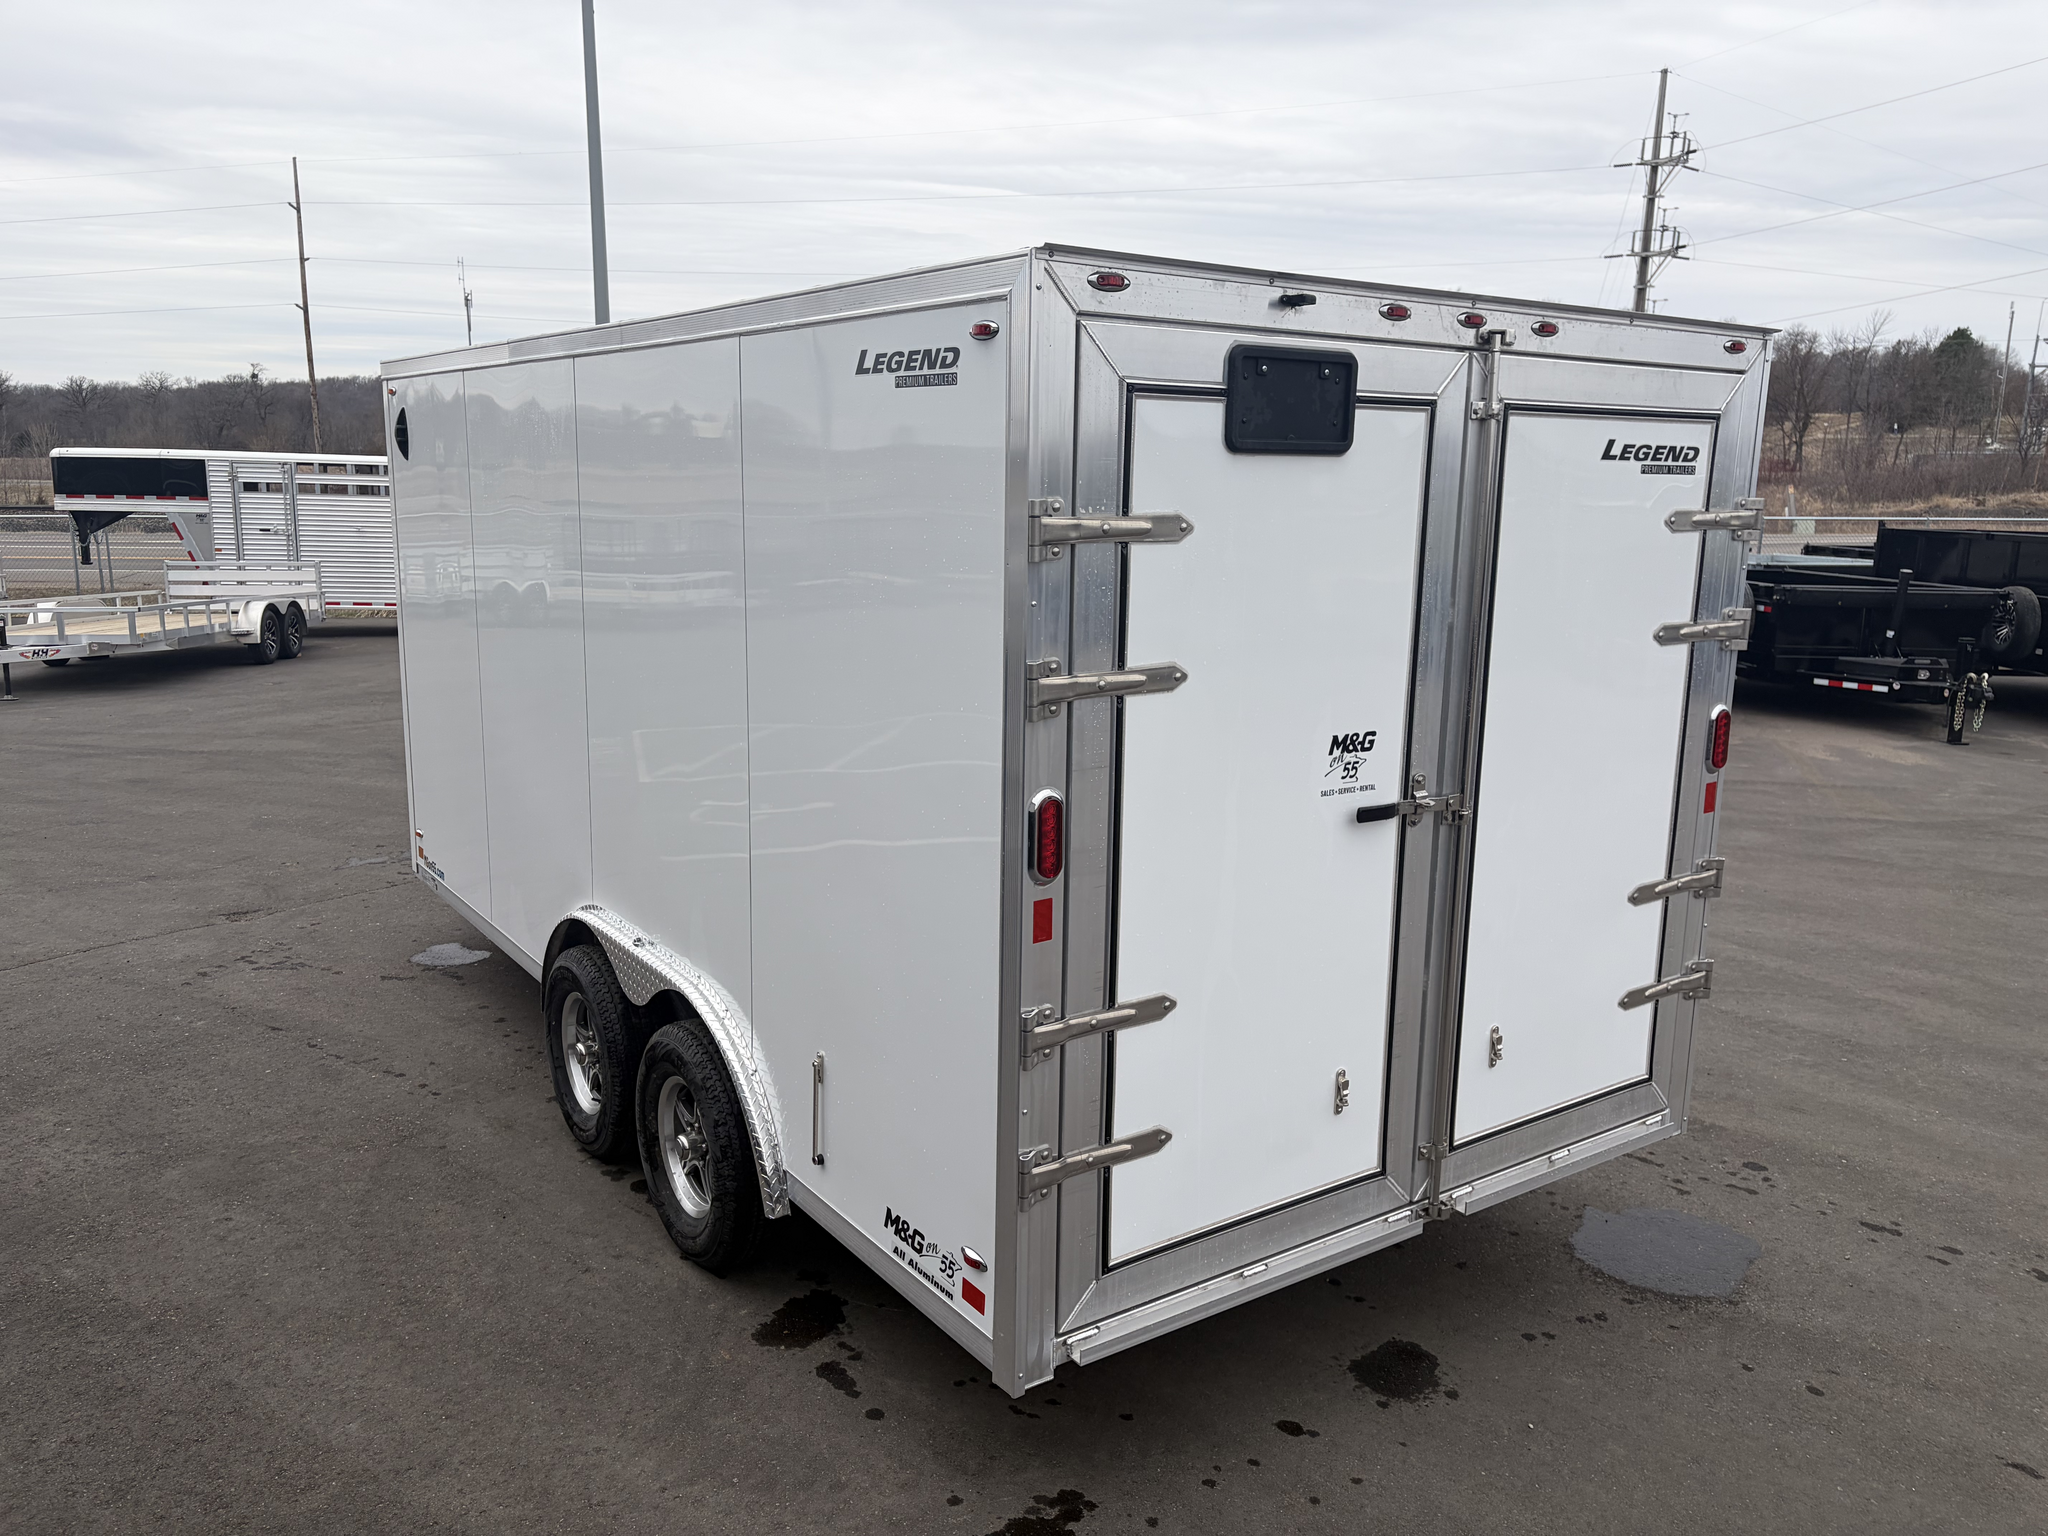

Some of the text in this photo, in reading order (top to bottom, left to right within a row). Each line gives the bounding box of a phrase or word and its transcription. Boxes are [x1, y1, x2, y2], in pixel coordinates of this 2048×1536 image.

[855, 346, 961, 375] LEGEND
[895, 373, 957, 387] PREMIUM TRAILERS
[1601, 439, 1700, 463] LEGEND
[1641, 465, 1696, 475] PREMIUM TRAILERS
[1328, 730, 1377, 756] M&G
[1341, 760, 1360, 780] 55
[883, 1205, 956, 1279] M&G on 55
[892, 1245, 954, 1301] All Aluminum
